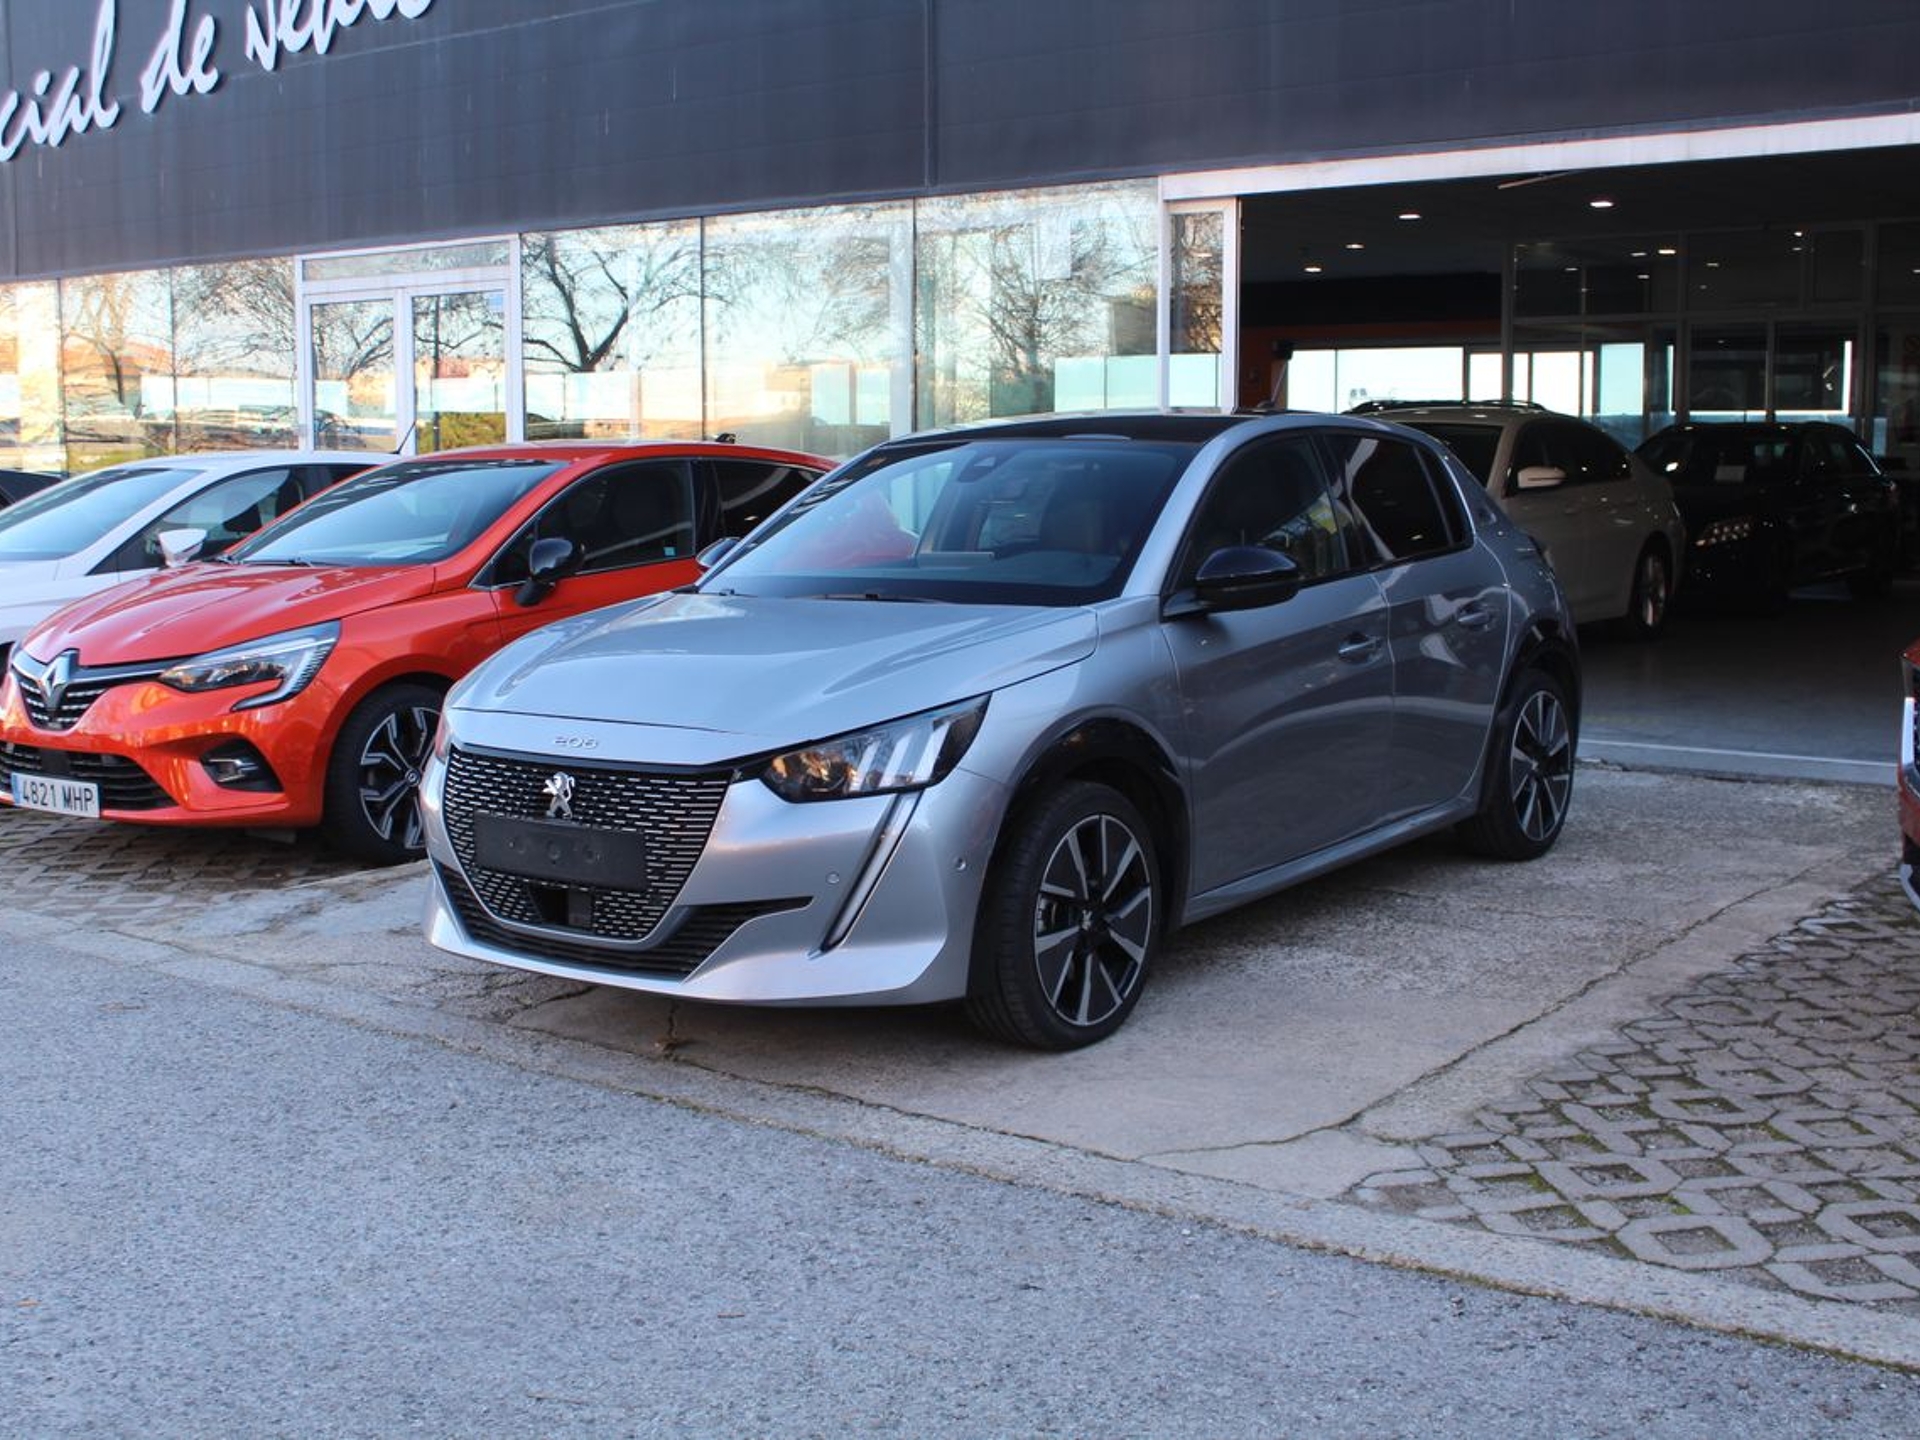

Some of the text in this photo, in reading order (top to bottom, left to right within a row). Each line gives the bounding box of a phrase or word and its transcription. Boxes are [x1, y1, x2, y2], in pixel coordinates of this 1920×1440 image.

[140, 0, 220, 113] de
[23, 780, 94, 811] 4821 MHP
